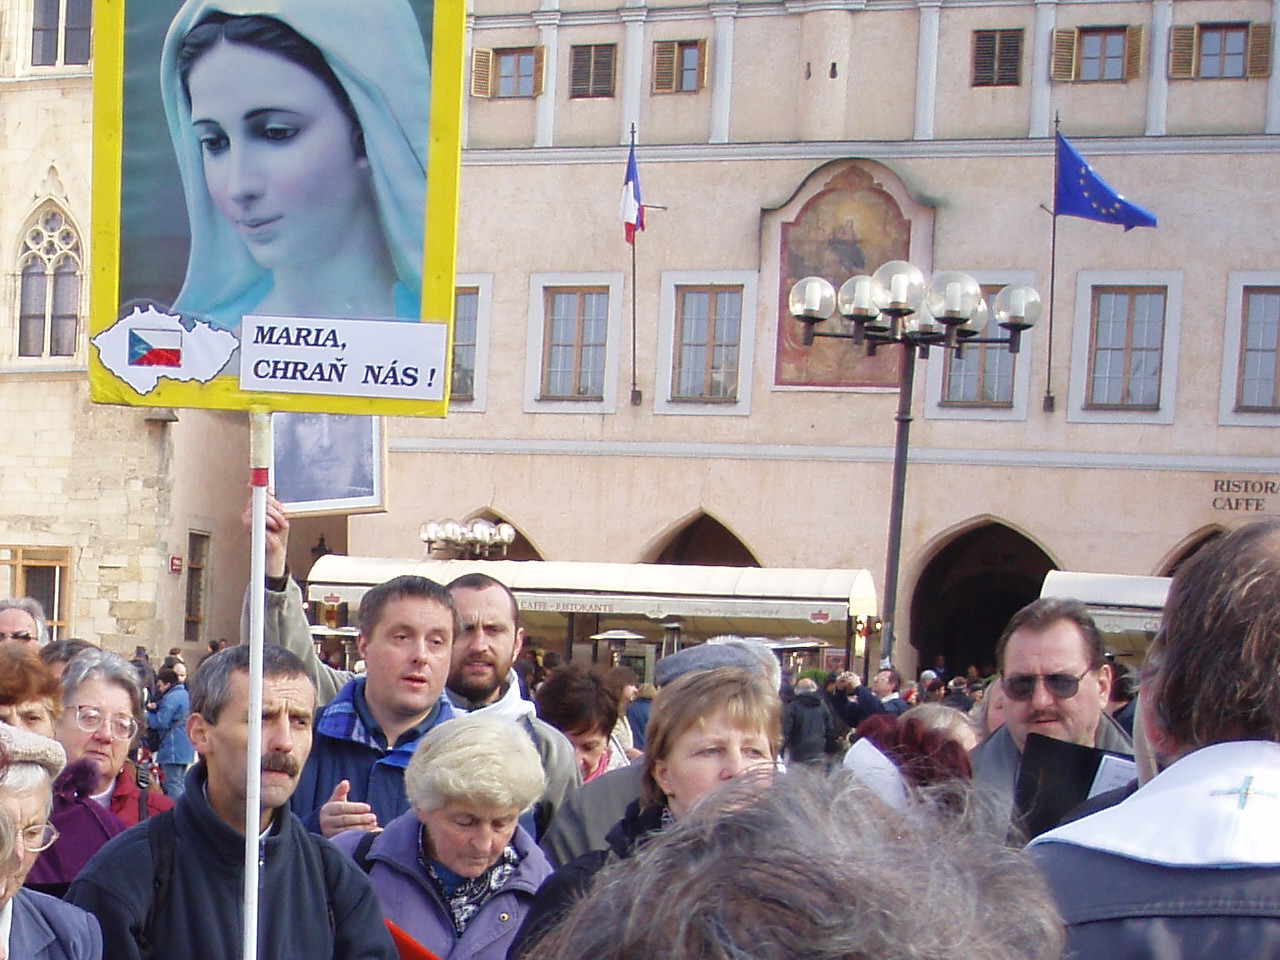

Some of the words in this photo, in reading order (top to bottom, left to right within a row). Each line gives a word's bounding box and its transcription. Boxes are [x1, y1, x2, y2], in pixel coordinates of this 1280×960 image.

[252, 325, 347, 351] MARIA,
[253, 357, 347, 384] CHRAŇ
[361, 360, 419, 387] NÁS
[1212, 497, 1265, 511] CAFFE
